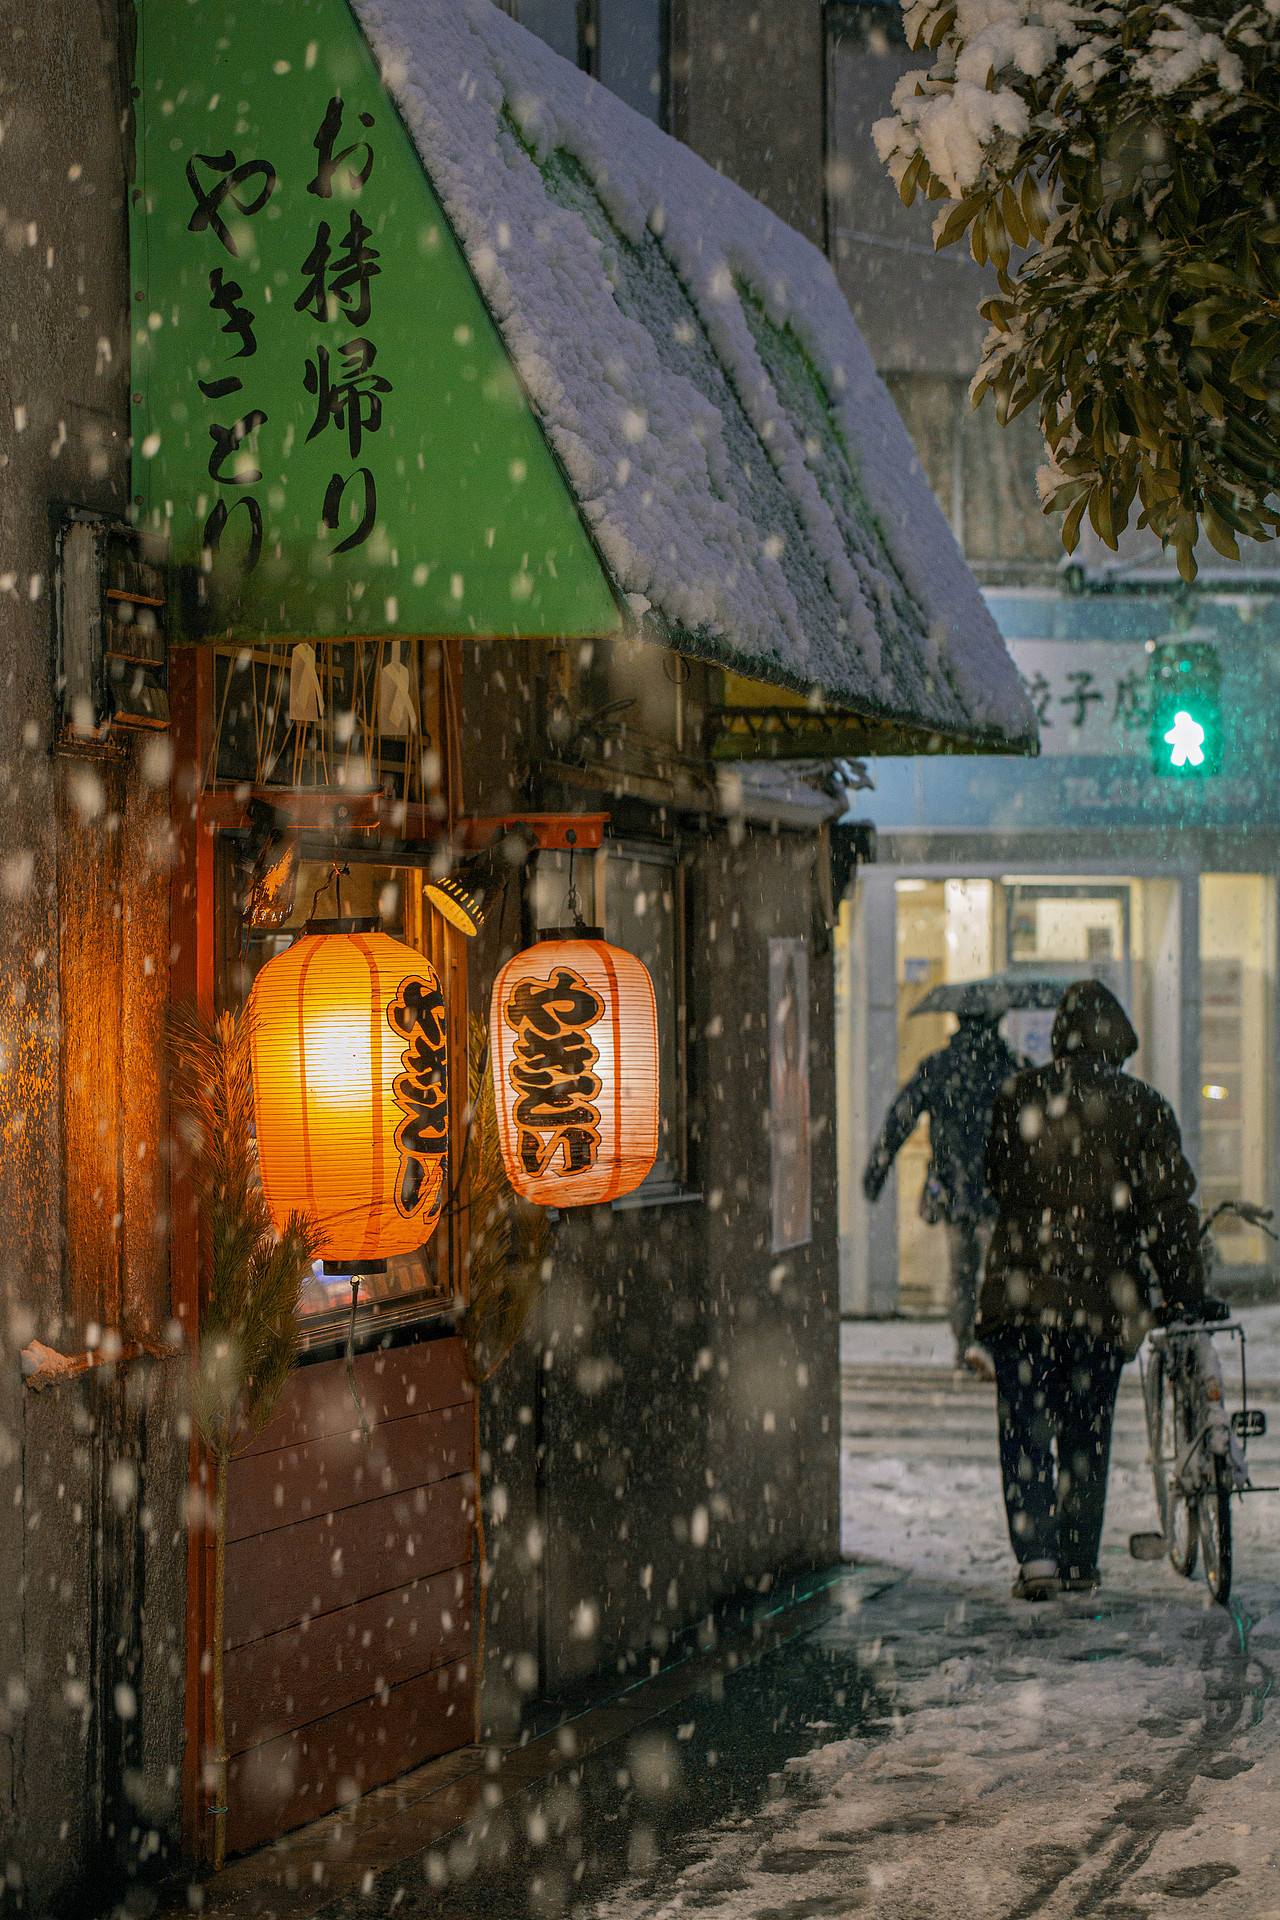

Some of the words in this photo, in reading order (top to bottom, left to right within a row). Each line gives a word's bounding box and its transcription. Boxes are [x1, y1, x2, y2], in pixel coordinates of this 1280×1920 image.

[294, 97, 393, 557] お持帰り
[504, 966, 605, 1178] やきとり
